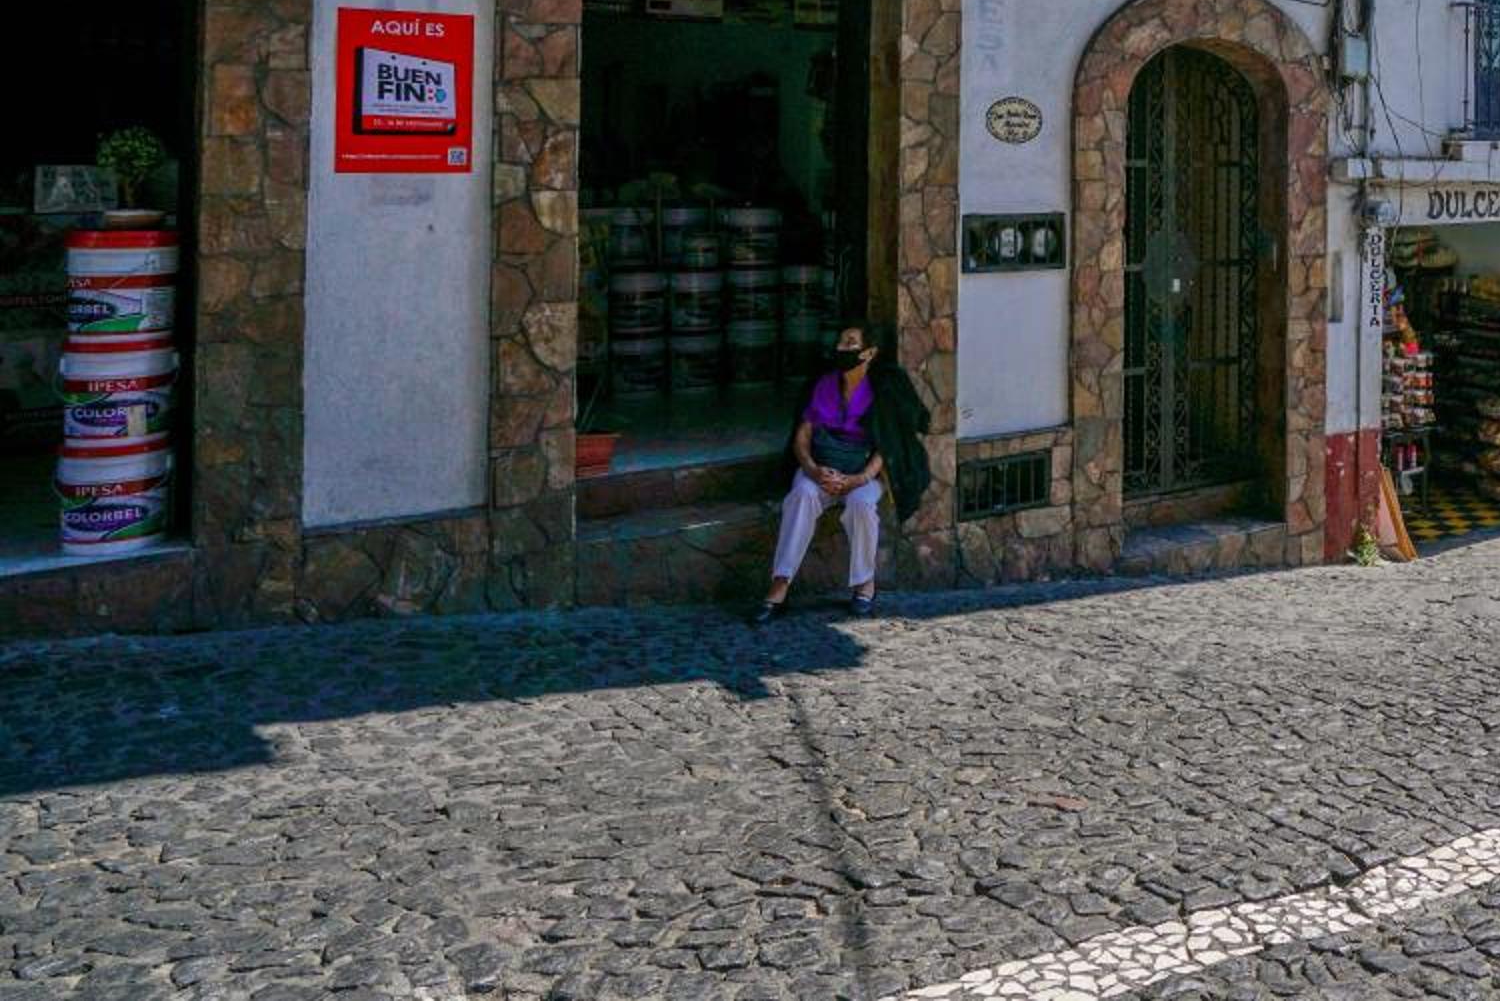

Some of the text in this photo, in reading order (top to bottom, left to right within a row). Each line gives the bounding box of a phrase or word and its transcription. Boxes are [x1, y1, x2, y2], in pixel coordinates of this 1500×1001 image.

[371, 18, 446, 38] AQUÍ ES
[377, 62, 443, 87] BUEN
[377, 81, 426, 103] FIN
[88, 379, 140, 392] IPESA
[75, 484, 124, 496] IPESA
[65, 508, 143, 523] COLORBEL
